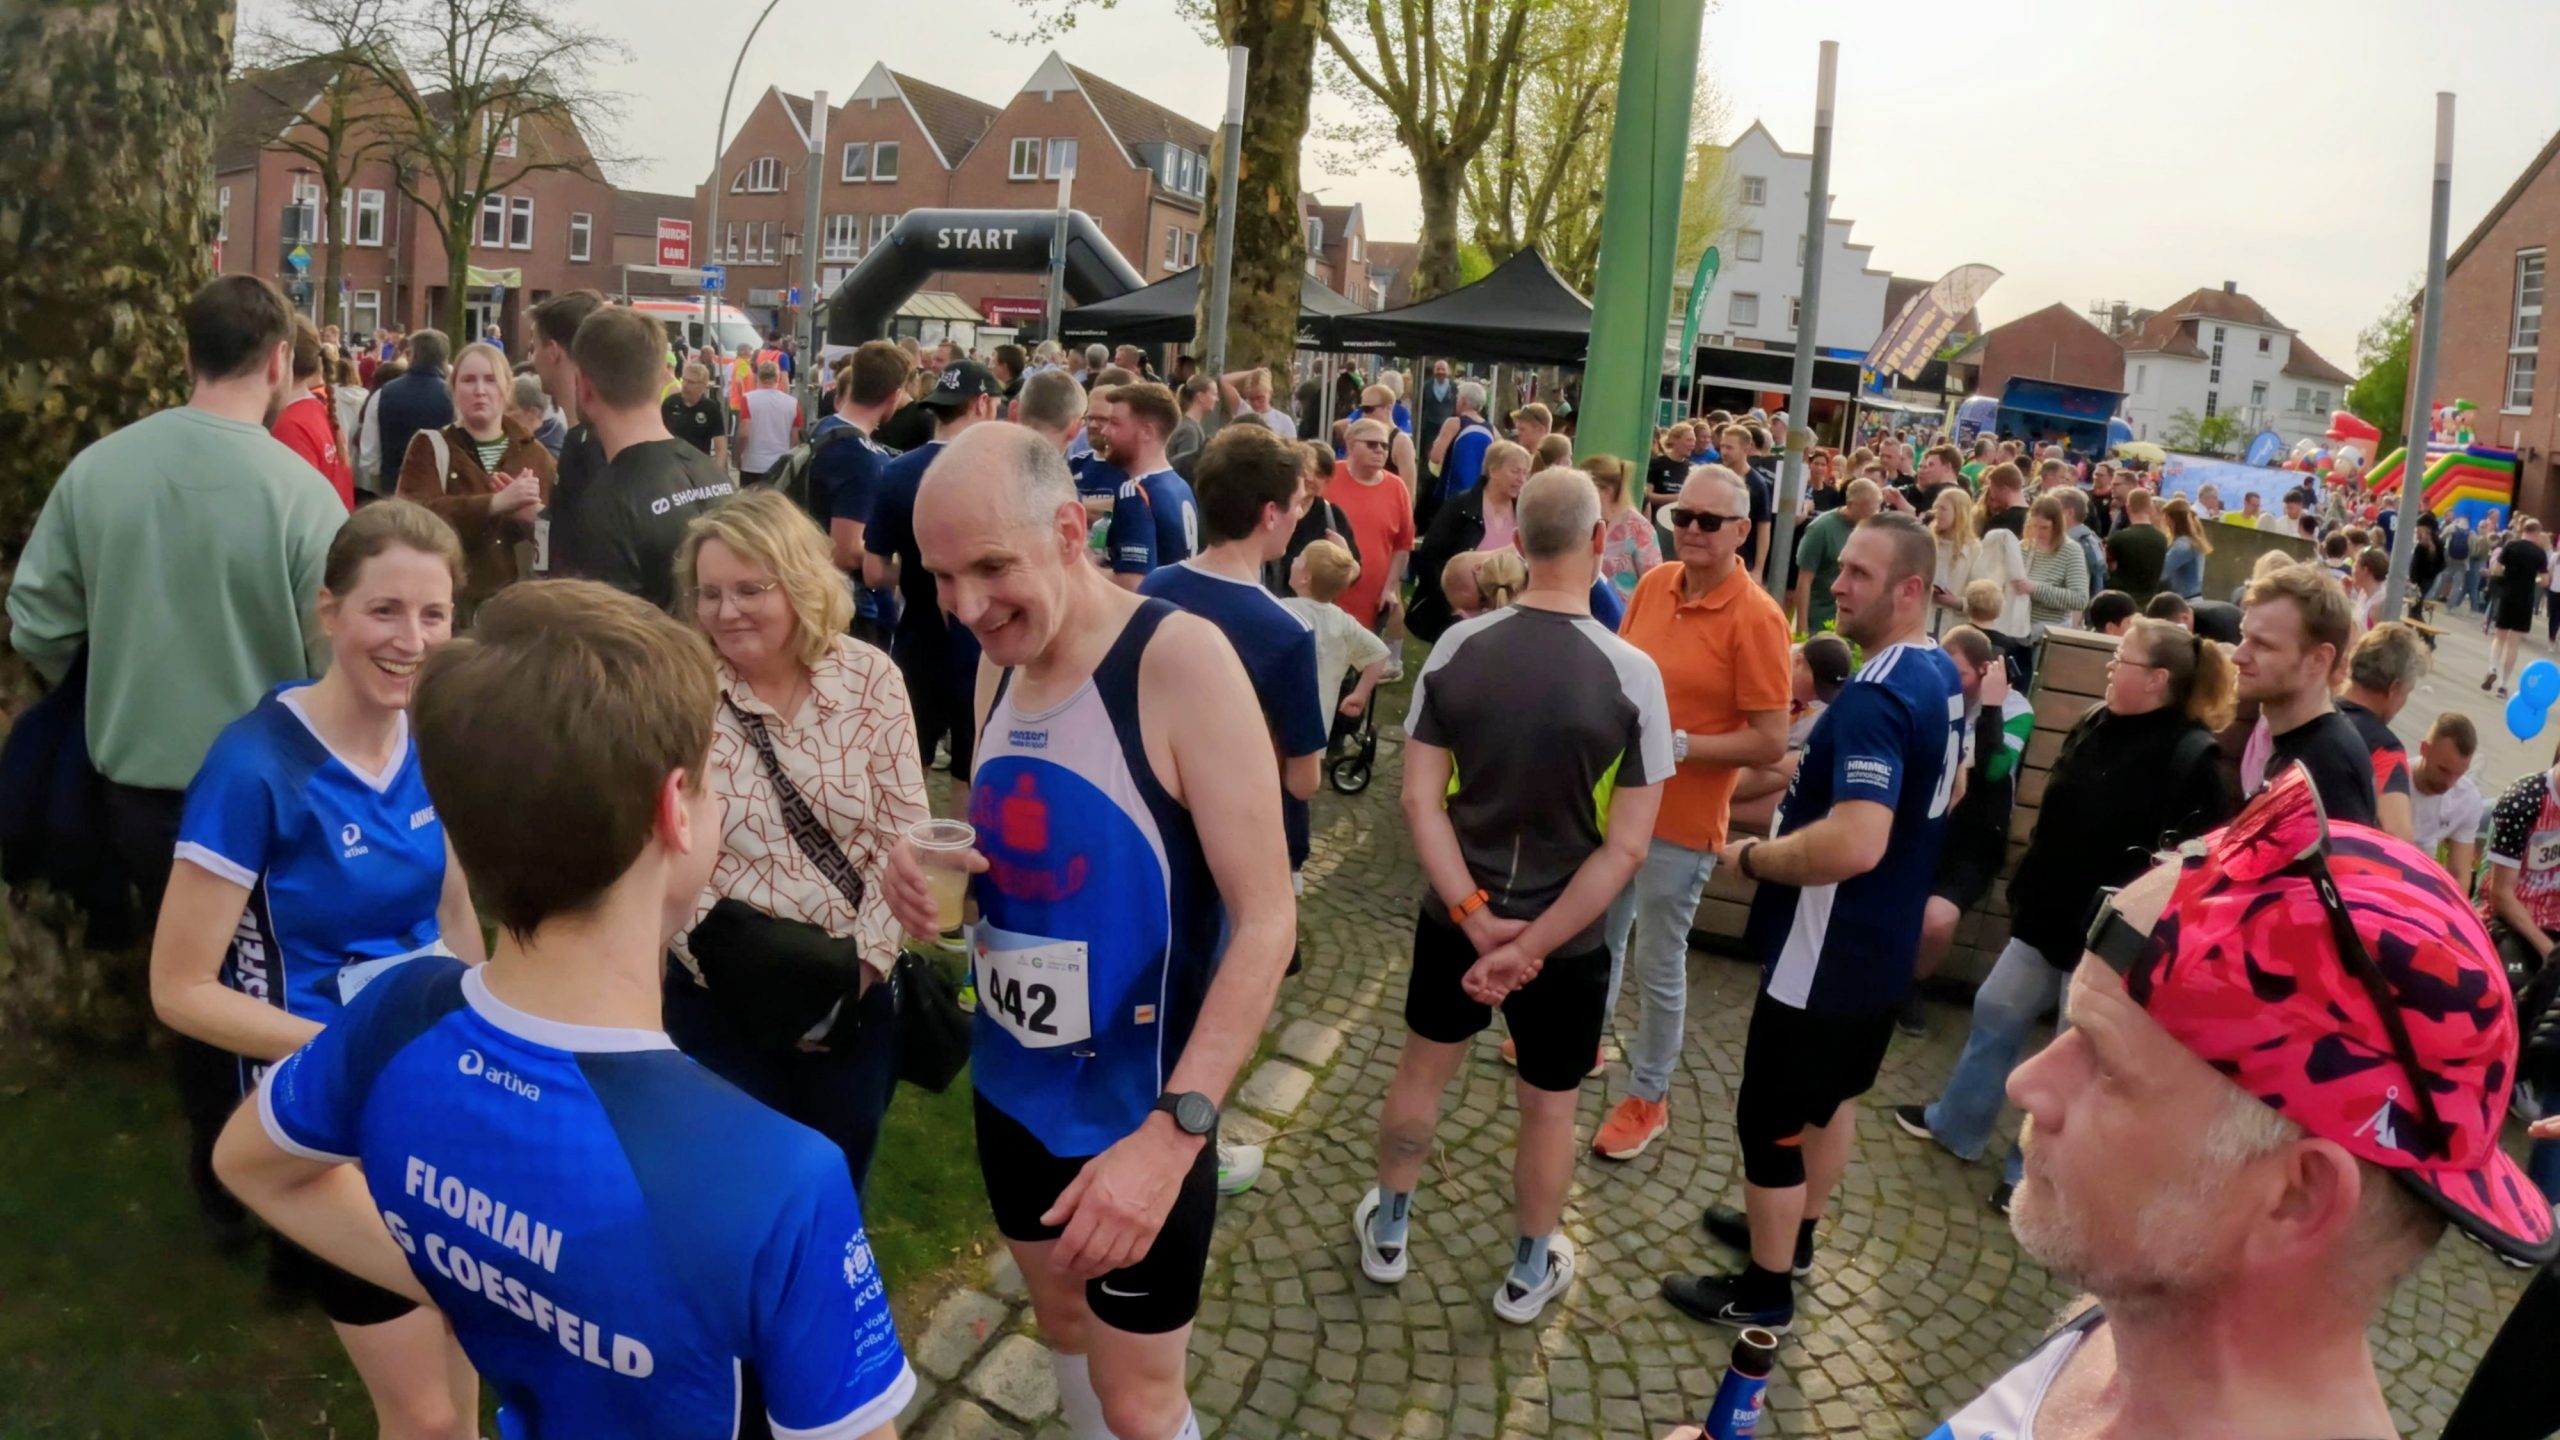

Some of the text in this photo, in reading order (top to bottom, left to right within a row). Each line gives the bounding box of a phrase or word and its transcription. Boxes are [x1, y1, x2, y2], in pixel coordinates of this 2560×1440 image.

[938, 227, 1018, 250] START
[664, 247, 685, 260] GANG
[1847, 760, 1890, 776] HIMMEL
[344, 845, 368, 858] artiva
[989, 966, 1058, 1036] 442
[486, 1067, 541, 1101] artiva
[406, 1155, 563, 1273] FLORIAN
[424, 1233, 654, 1378] COESFELD
